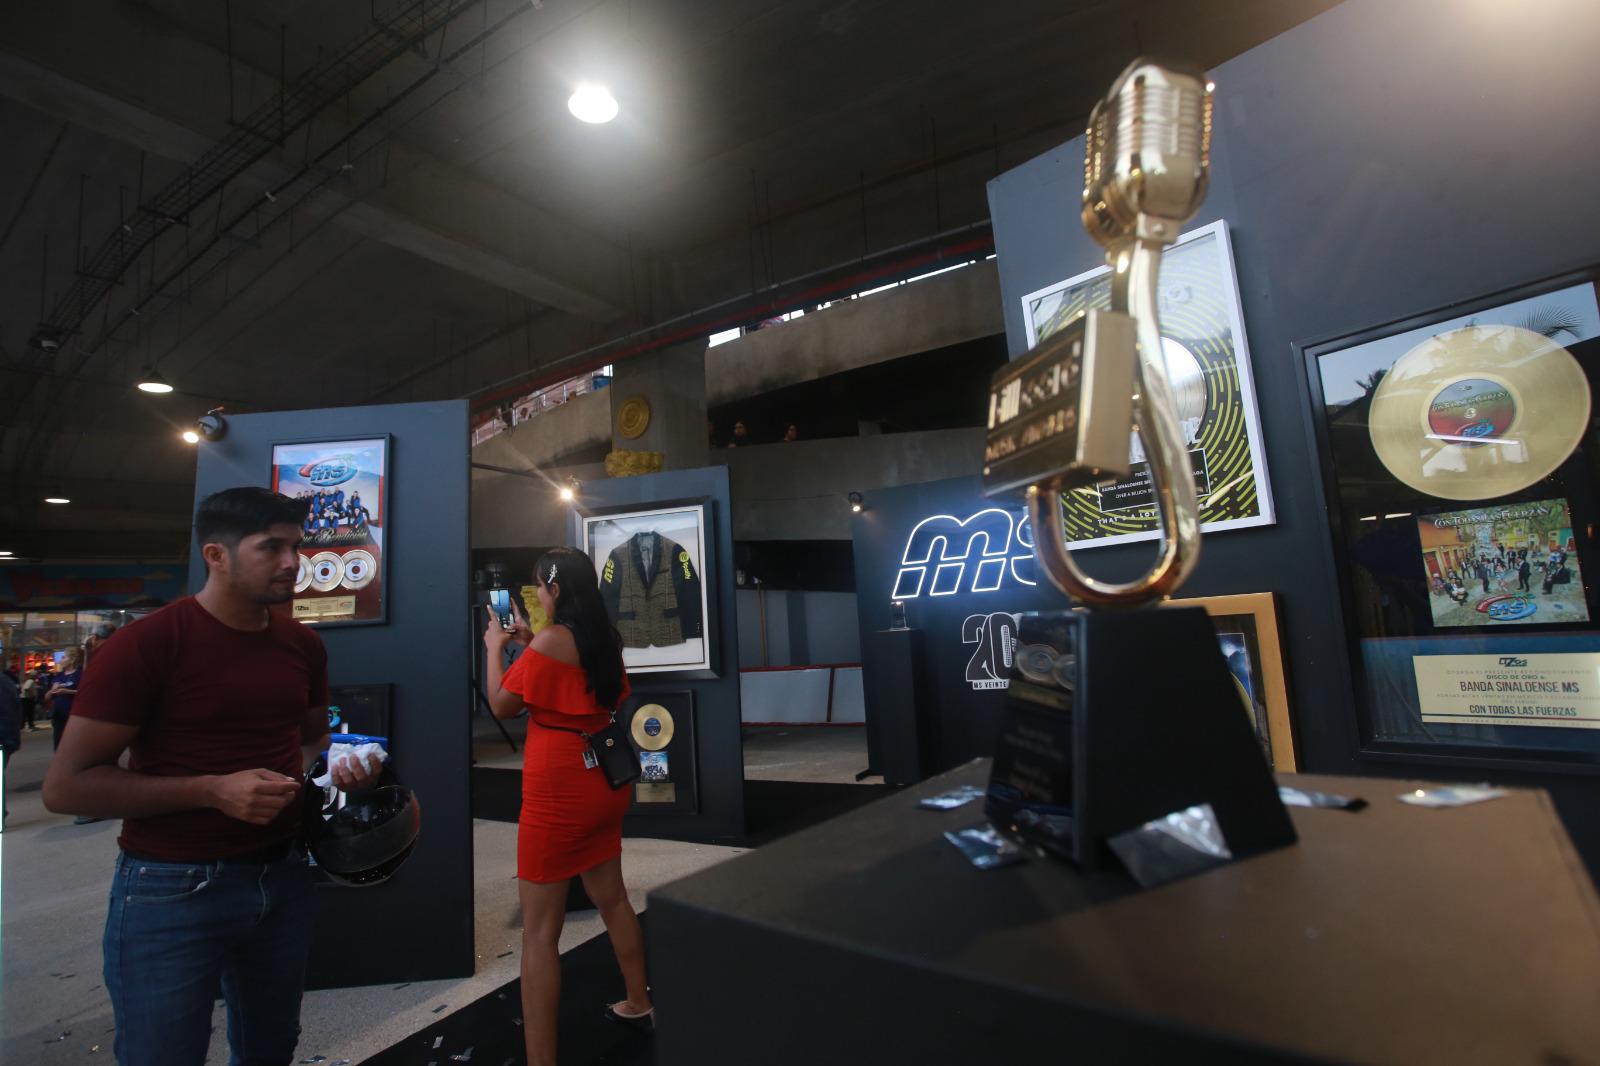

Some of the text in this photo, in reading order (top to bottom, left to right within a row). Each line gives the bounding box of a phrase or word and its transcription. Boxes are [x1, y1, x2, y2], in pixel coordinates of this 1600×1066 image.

[1460, 681, 1580, 693] BANDA SINALOENSE MS
[1469, 704, 1577, 717] CON TODAS LAS FUERZAS
